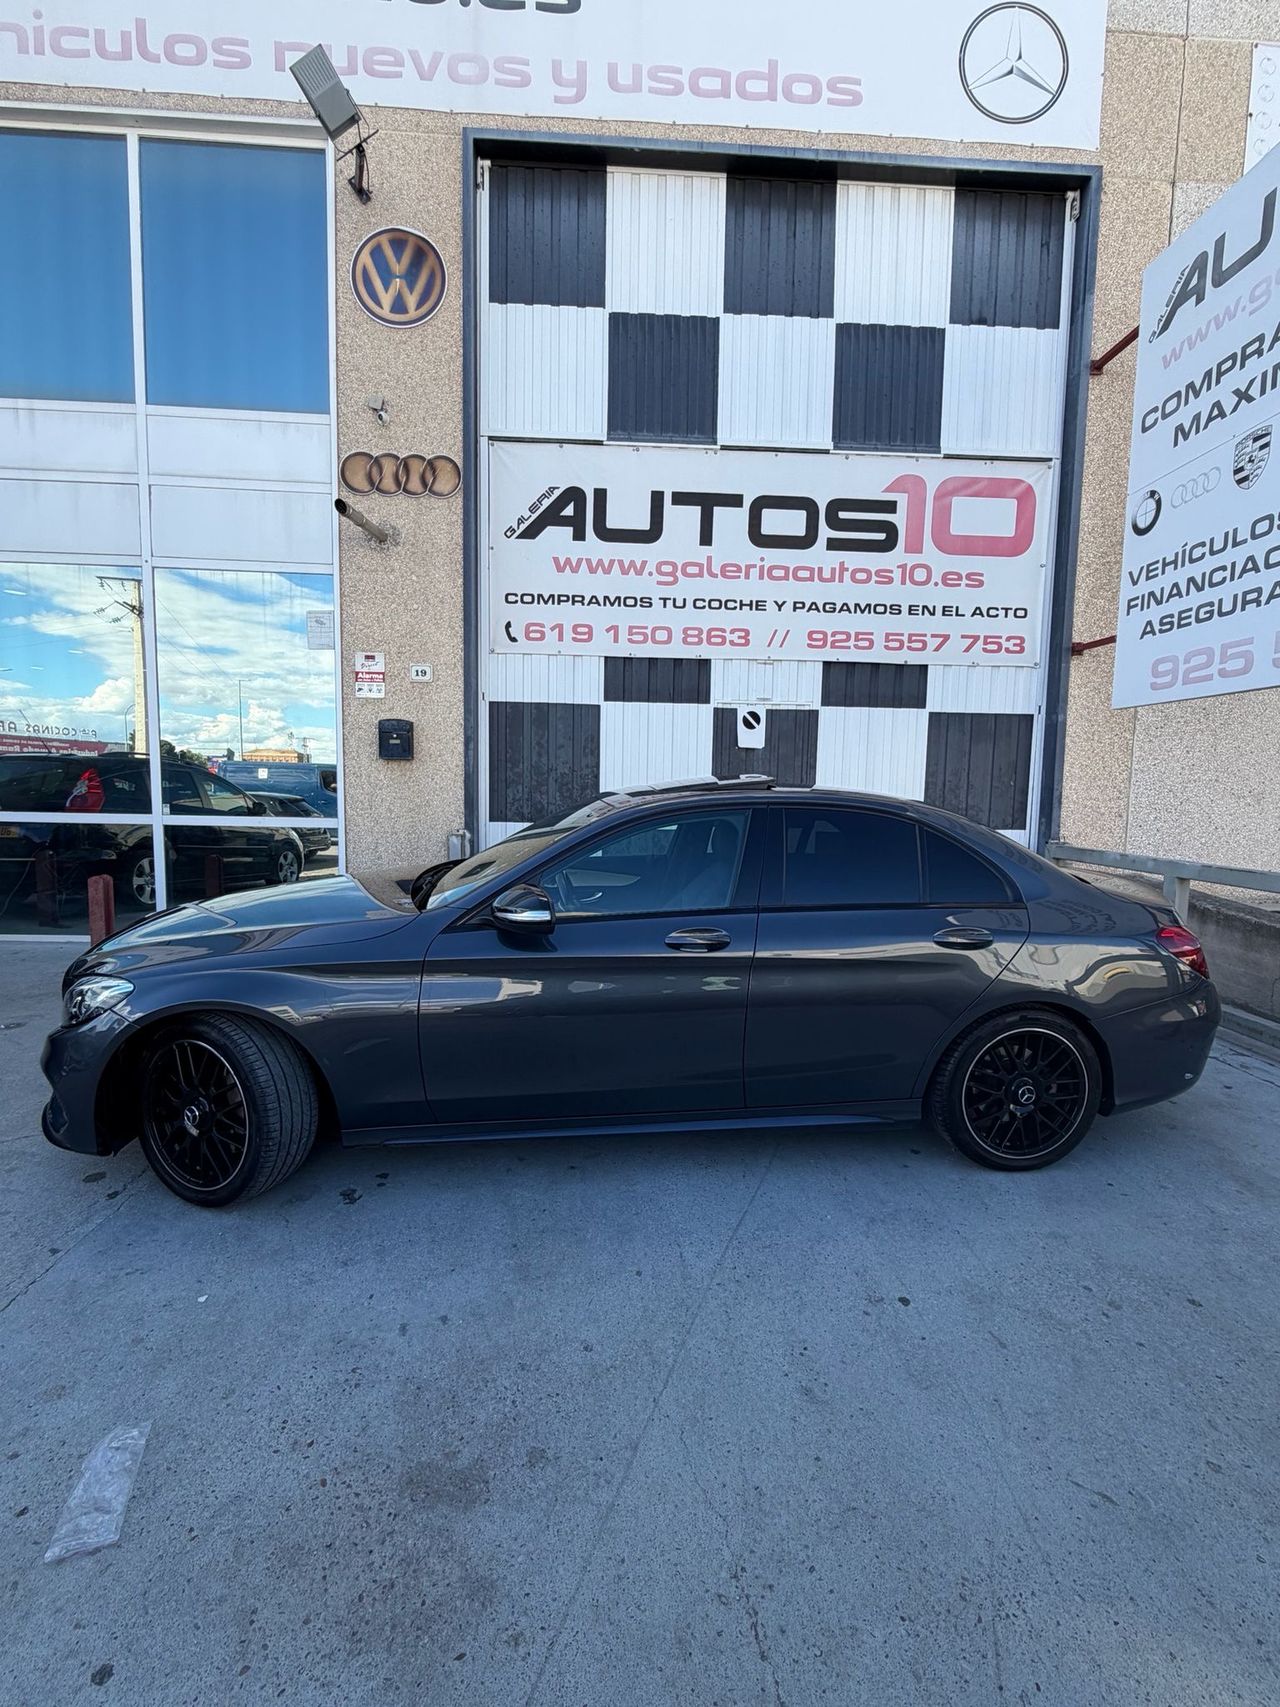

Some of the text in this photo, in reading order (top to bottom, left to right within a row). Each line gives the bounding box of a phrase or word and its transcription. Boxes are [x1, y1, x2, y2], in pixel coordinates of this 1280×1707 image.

[273, 40, 532, 88] nuevos
[551, 58, 587, 104] y
[607, 59, 864, 107] usados
[1148, 264, 1190, 344] GALERIA
[1162, 266, 1280, 371] www.g
[504, 486, 561, 539] GALERIA
[552, 555, 985, 588] www.galeriaautos10.es
[1128, 511, 1280, 587] VEHÍCULO
[504, 592, 1028, 619] COMPRAMOS TU COCHE Y PAGAMOS EN EL ACTO
[524, 622, 594, 643] 619
[605, 624, 673, 645] 150
[681, 626, 751, 647] 863
[806, 630, 875, 650] 925
[883, 632, 951, 652] 557
[960, 633, 1026, 654] 753
[1150, 636, 1254, 691] 925
[414, 669, 427, 677] 19
